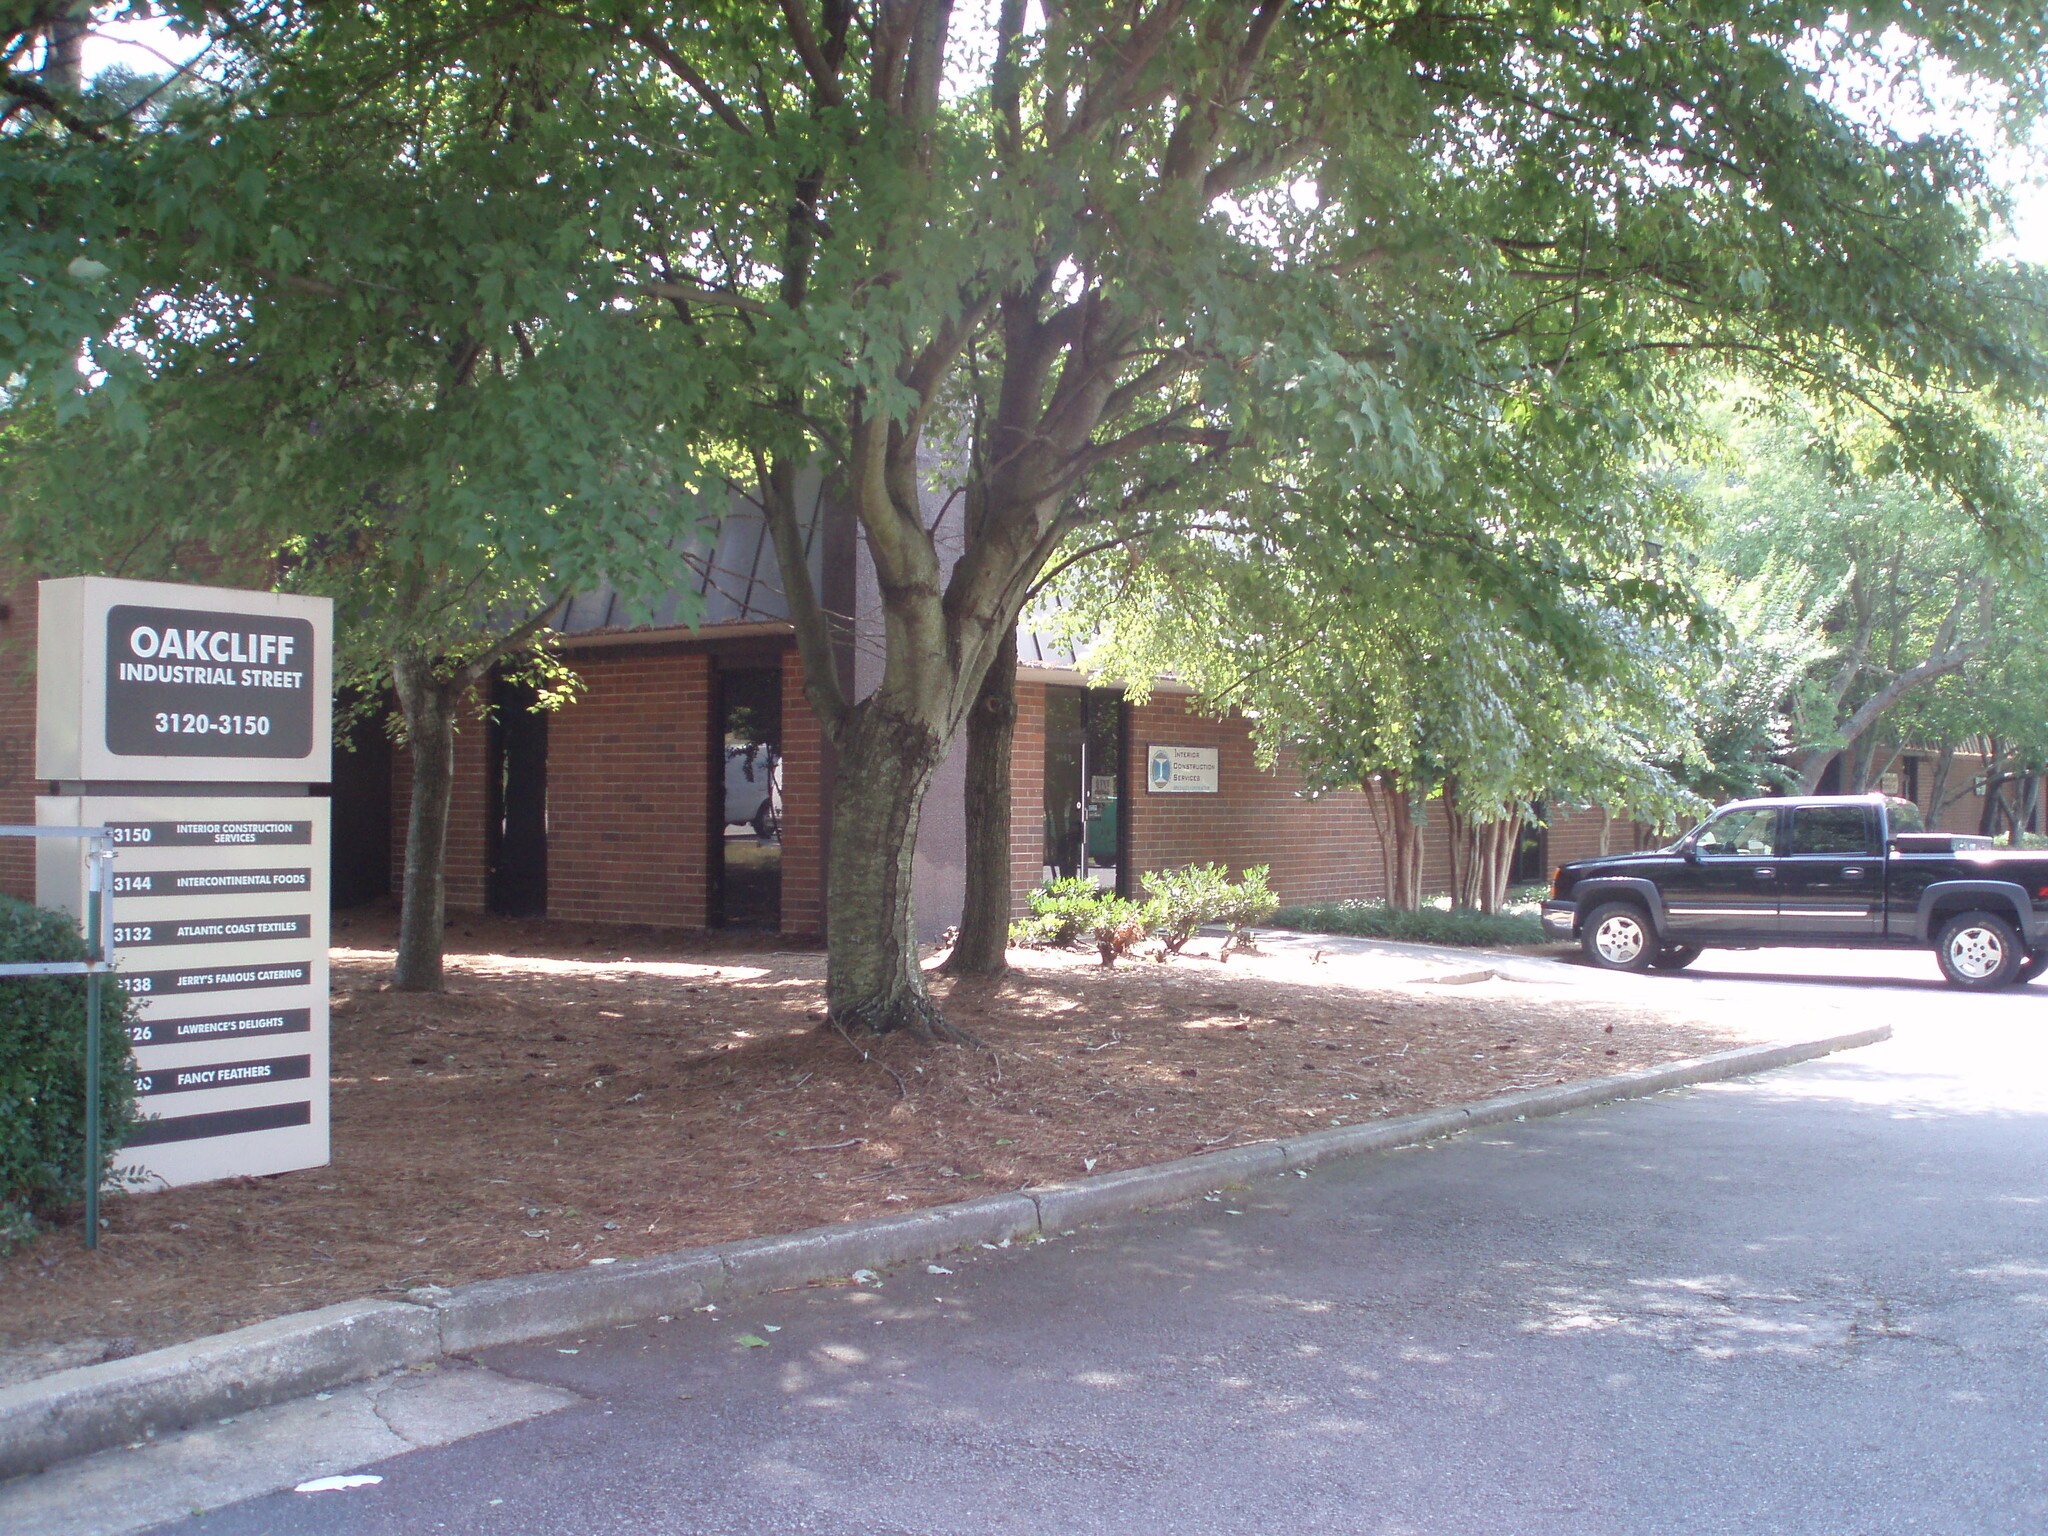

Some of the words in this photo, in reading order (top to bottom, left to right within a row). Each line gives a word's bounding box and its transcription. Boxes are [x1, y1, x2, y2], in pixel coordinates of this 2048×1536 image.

[130, 625, 294, 665] OAKCLIFF
[119, 662, 236, 686] INDUSTRIAL
[241, 669, 303, 689] STREET
[155, 712, 270, 735] 3120-3150
[114, 828, 152, 842] 3150
[176, 824, 220, 834] INTERIOR
[222, 824, 292, 833] CONSTRUCTION
[214, 834, 256, 842] SERVICES
[114, 876, 152, 891] 3144
[177, 876, 272, 887] INTERCONTINENTAL
[273, 874, 306, 884] FOODS
[114, 927, 152, 942] 3132
[177, 925, 223, 937] ATLANTIC
[225, 924, 256, 935] COAST
[257, 922, 297, 933] TEXTILES
[177, 974, 213, 986] JERRY'S
[216, 972, 256, 984] FAMOUS
[257, 969, 302, 980] CATERING
[178, 1021, 236, 1035] LAWRENCE'S
[238, 1018, 284, 1030] DELIGHTS
[178, 1071, 216, 1085] FANCY
[218, 1065, 271, 1080] FEATHERS
